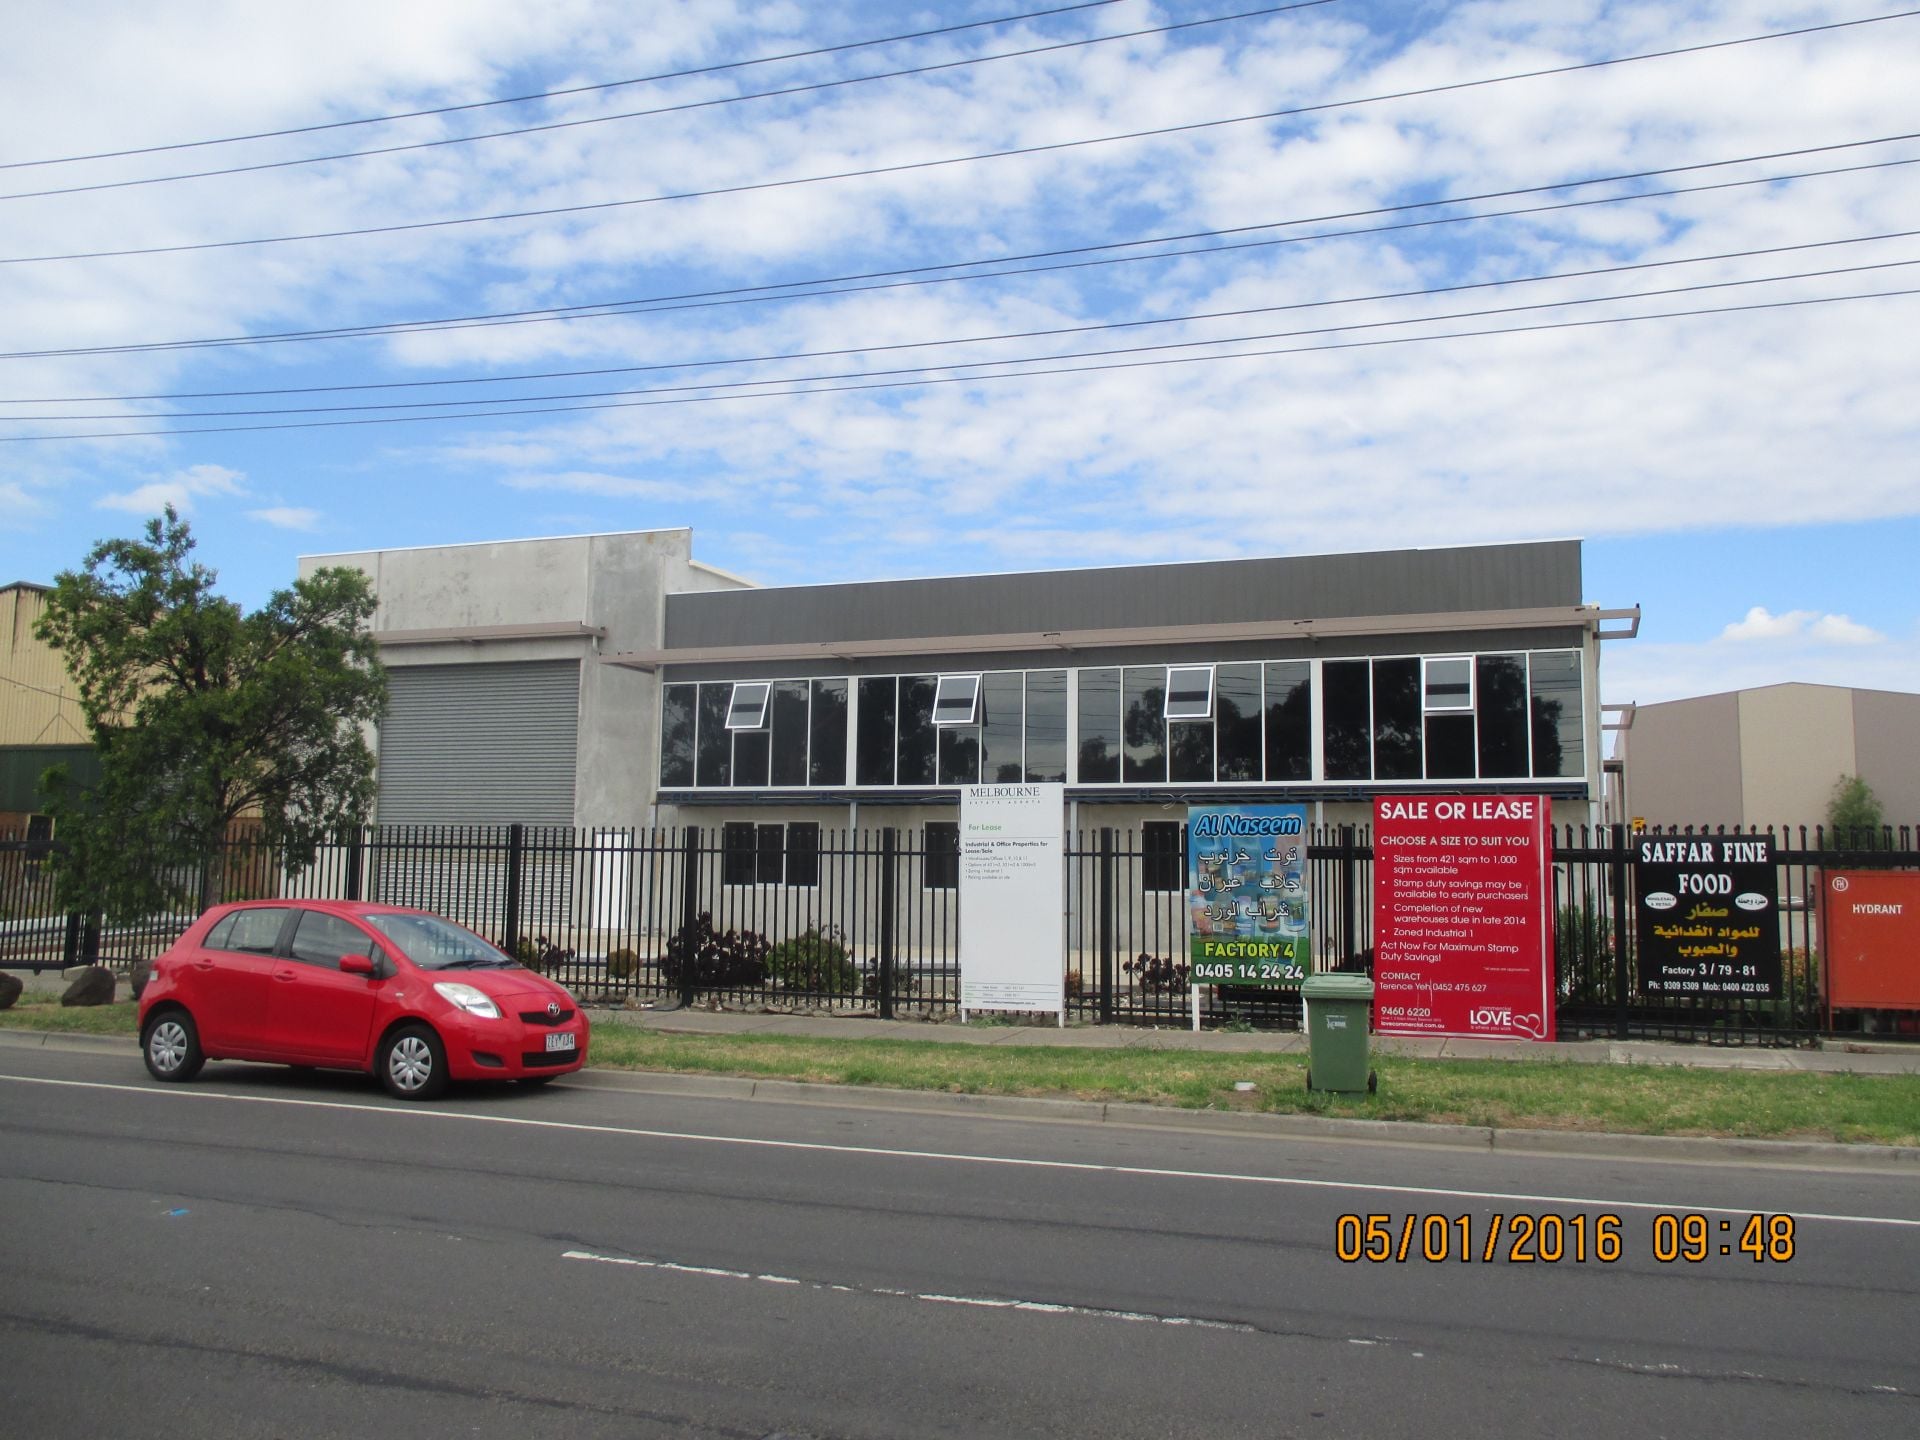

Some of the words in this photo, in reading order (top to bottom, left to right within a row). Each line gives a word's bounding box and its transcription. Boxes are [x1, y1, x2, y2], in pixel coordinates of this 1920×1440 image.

[970, 787, 1040, 797] MELBOURNE
[1380, 802, 1428, 819] SALE
[1434, 802, 1466, 819] OR
[1472, 802, 1532, 819] LEASE
[1195, 814, 1220, 836] Al
[1222, 814, 1302, 836] Naseem
[1380, 836, 1426, 846] CHOOSE
[1430, 836, 1438, 846] A
[1440, 836, 1460, 846] SIZE
[1464, 836, 1478, 846] TO
[1481, 836, 1502, 846] SUIT
[1506, 836, 1530, 846] YOU
[1198, 849, 1250, 866] خرنوب
[1264, 847, 1298, 866] توت
[1642, 842, 1714, 862] SAFFAR
[1723, 842, 1768, 862] FINE
[1394, 855, 1414, 863] Sizes
[1416, 855, 1438, 863] from
[1440, 855, 1456, 864] 421
[1458, 857, 1478, 866] sqm
[1480, 856, 1490, 864] to
[1394, 867, 1412, 876] sqm
[1415, 866, 1458, 874] available
[1199, 874, 1241, 892] عيران
[1260, 874, 1300, 894] جلاب
[1394, 880, 1424, 889] Stamp
[1426, 880, 1446, 890] duty
[1449, 881, 1482, 890] savings
[1485, 882, 1506, 890] may
[1508, 881, 1522, 889] be
[1678, 874, 1732, 894] FOOD
[1394, 890, 1436, 898] available
[1440, 890, 1448, 898] to
[1452, 890, 1474, 900] early
[1476, 892, 1528, 901] purchasers
[1204, 901, 1240, 920] الورد
[1246, 901, 1289, 921] شراب
[1394, 904, 1448, 914] Completion
[1451, 904, 1462, 912] of
[1685, 902, 1728, 920] صفار
[1852, 904, 1902, 914] HYDRANT
[1394, 915, 1448, 924] warehouses
[1451, 916, 1470, 924] due
[1472, 916, 1481, 924] in
[1483, 916, 1501, 924] late
[1504, 916, 1526, 924] 2014
[1394, 928, 1424, 936] Zoned
[1426, 928, 1466, 937] Industrial
[1654, 924, 1712, 938] الغذائية
[1718, 926, 1760, 940] للمواد
[1205, 942, 1280, 957] FACTORY
[1284, 944, 1294, 958] 4
[1381, 942, 1397, 950] Act
[1400, 942, 1420, 950] Now
[1423, 942, 1438, 950] For
[1440, 942, 1486, 952] Maximum
[1488, 944, 1518, 954] Stamp
[1678, 943, 1738, 958] والحبوب
[1381, 952, 1402, 962] Duty
[1404, 953, 1441, 963] Savings!
[1196, 964, 1233, 978] 0405
[1238, 964, 1256, 978] 14
[1260, 964, 1280, 978] 24
[1284, 965, 1304, 979] 24
[1381, 972, 1421, 980] CONTACT
[1662, 966, 1696, 976] Factory
[1699, 963, 1707, 974] 3
[1710, 963, 1715, 975] /
[1718, 965, 1732, 975] 79
[1742, 966, 1756, 976] 81
[1380, 982, 1413, 990] Terence
[1414, 982, 1430, 990] Yeh
[1648, 981, 1660, 990] Ph:
[1664, 982, 1680, 990] 9309
[1682, 982, 1699, 990] 5309
[1702, 982, 1720, 990] Mob:
[1741, 983, 1754, 992] 422
[1380, 1006, 1404, 1016] 9460
[1406, 1008, 1430, 1016] 6220
[1380, 1020, 1444, 1028] lovecommercial.com.au
[1470, 1010, 1512, 1026] LOVE
